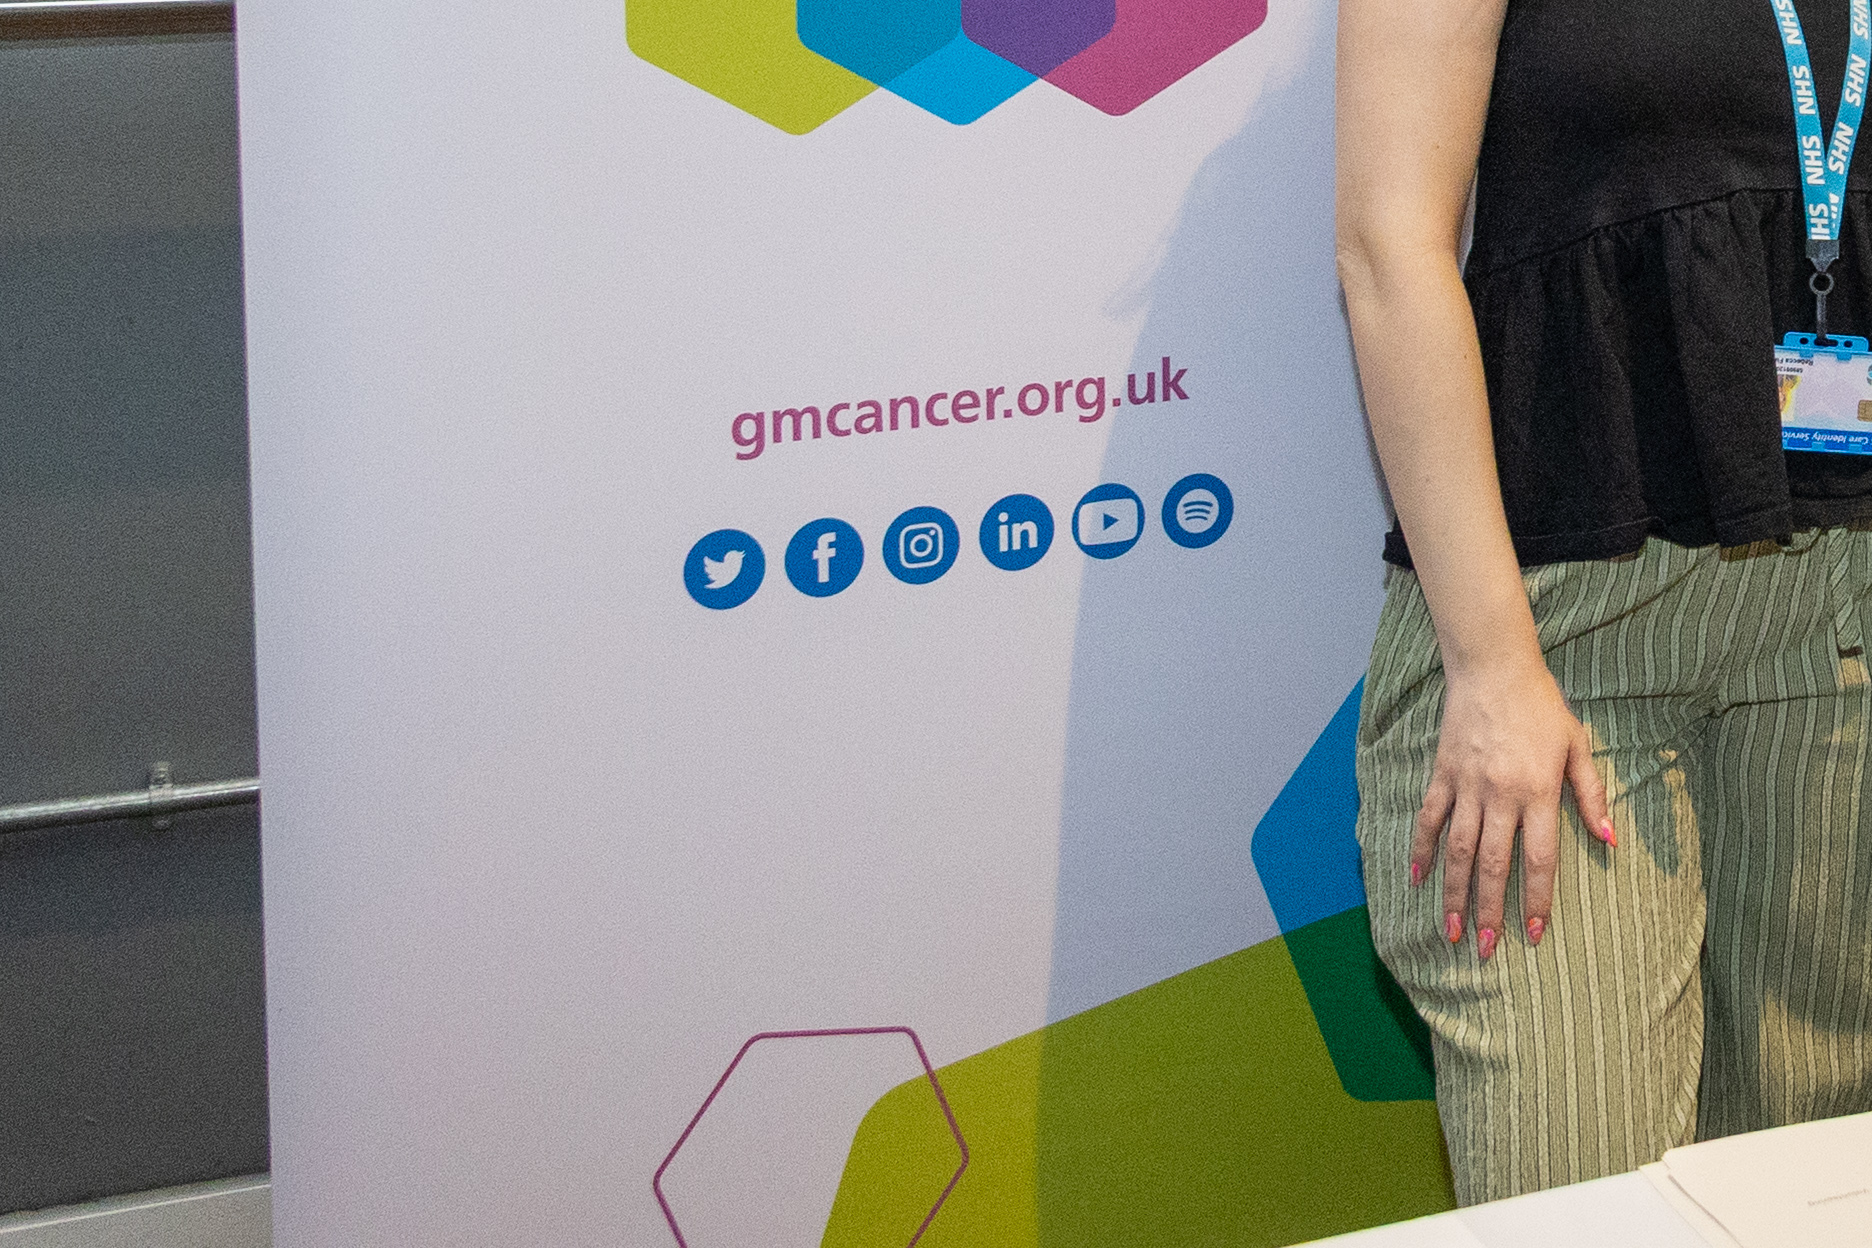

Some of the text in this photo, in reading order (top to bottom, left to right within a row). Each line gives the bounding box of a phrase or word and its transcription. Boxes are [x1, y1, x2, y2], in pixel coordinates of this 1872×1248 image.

[1792, 65, 1816, 115] NHS
[1845, 54, 1868, 107] NHS
[1802, 135, 1825, 186] NHS
[1828, 122, 1854, 175] NHS
[731, 355, 1190, 461] gmcancer.org.uk
[1783, 431, 1811, 442] Servic
[1812, 432, 1846, 443] Identity
[1849, 436, 1869, 445] Care
